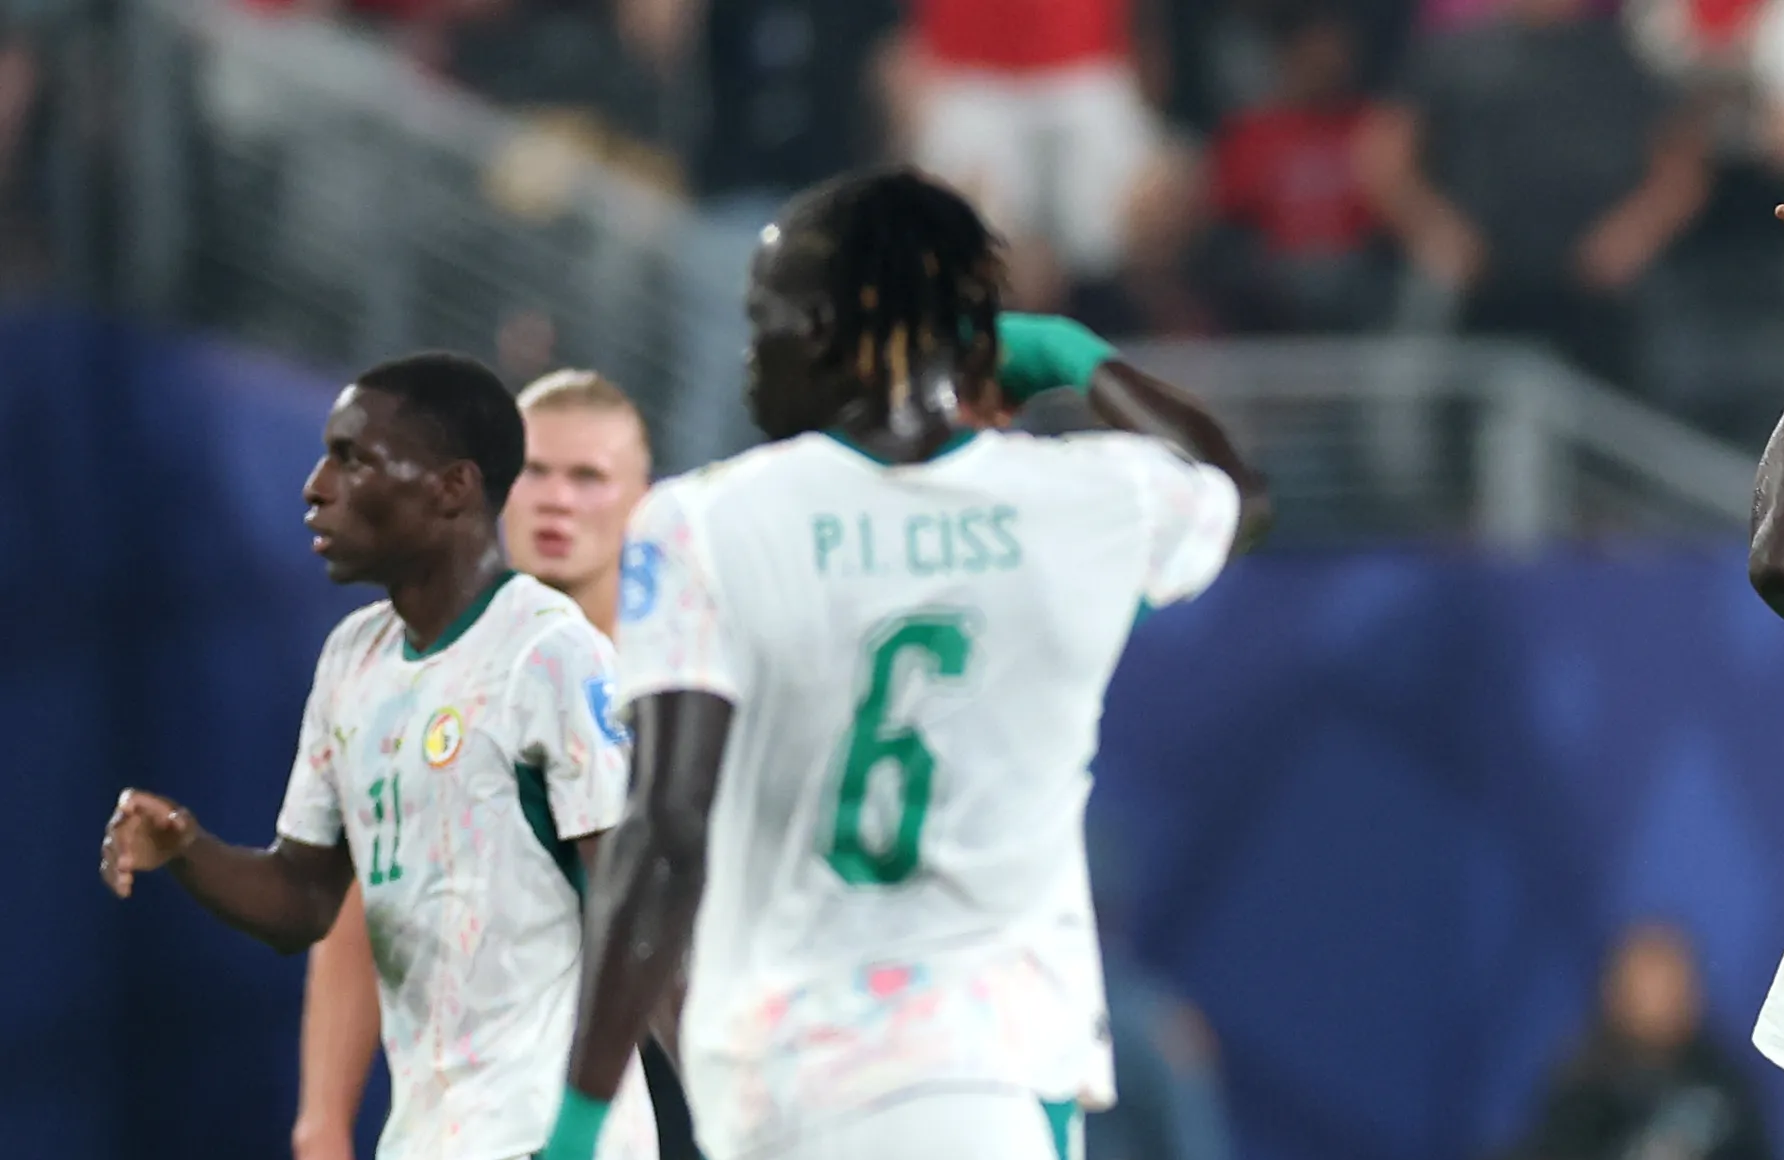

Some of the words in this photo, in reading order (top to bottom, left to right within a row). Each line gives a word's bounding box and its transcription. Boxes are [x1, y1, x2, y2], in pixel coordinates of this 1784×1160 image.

[904, 503, 1023, 577] CISS
[820, 606, 974, 886] 6
[368, 770, 404, 886] 11
